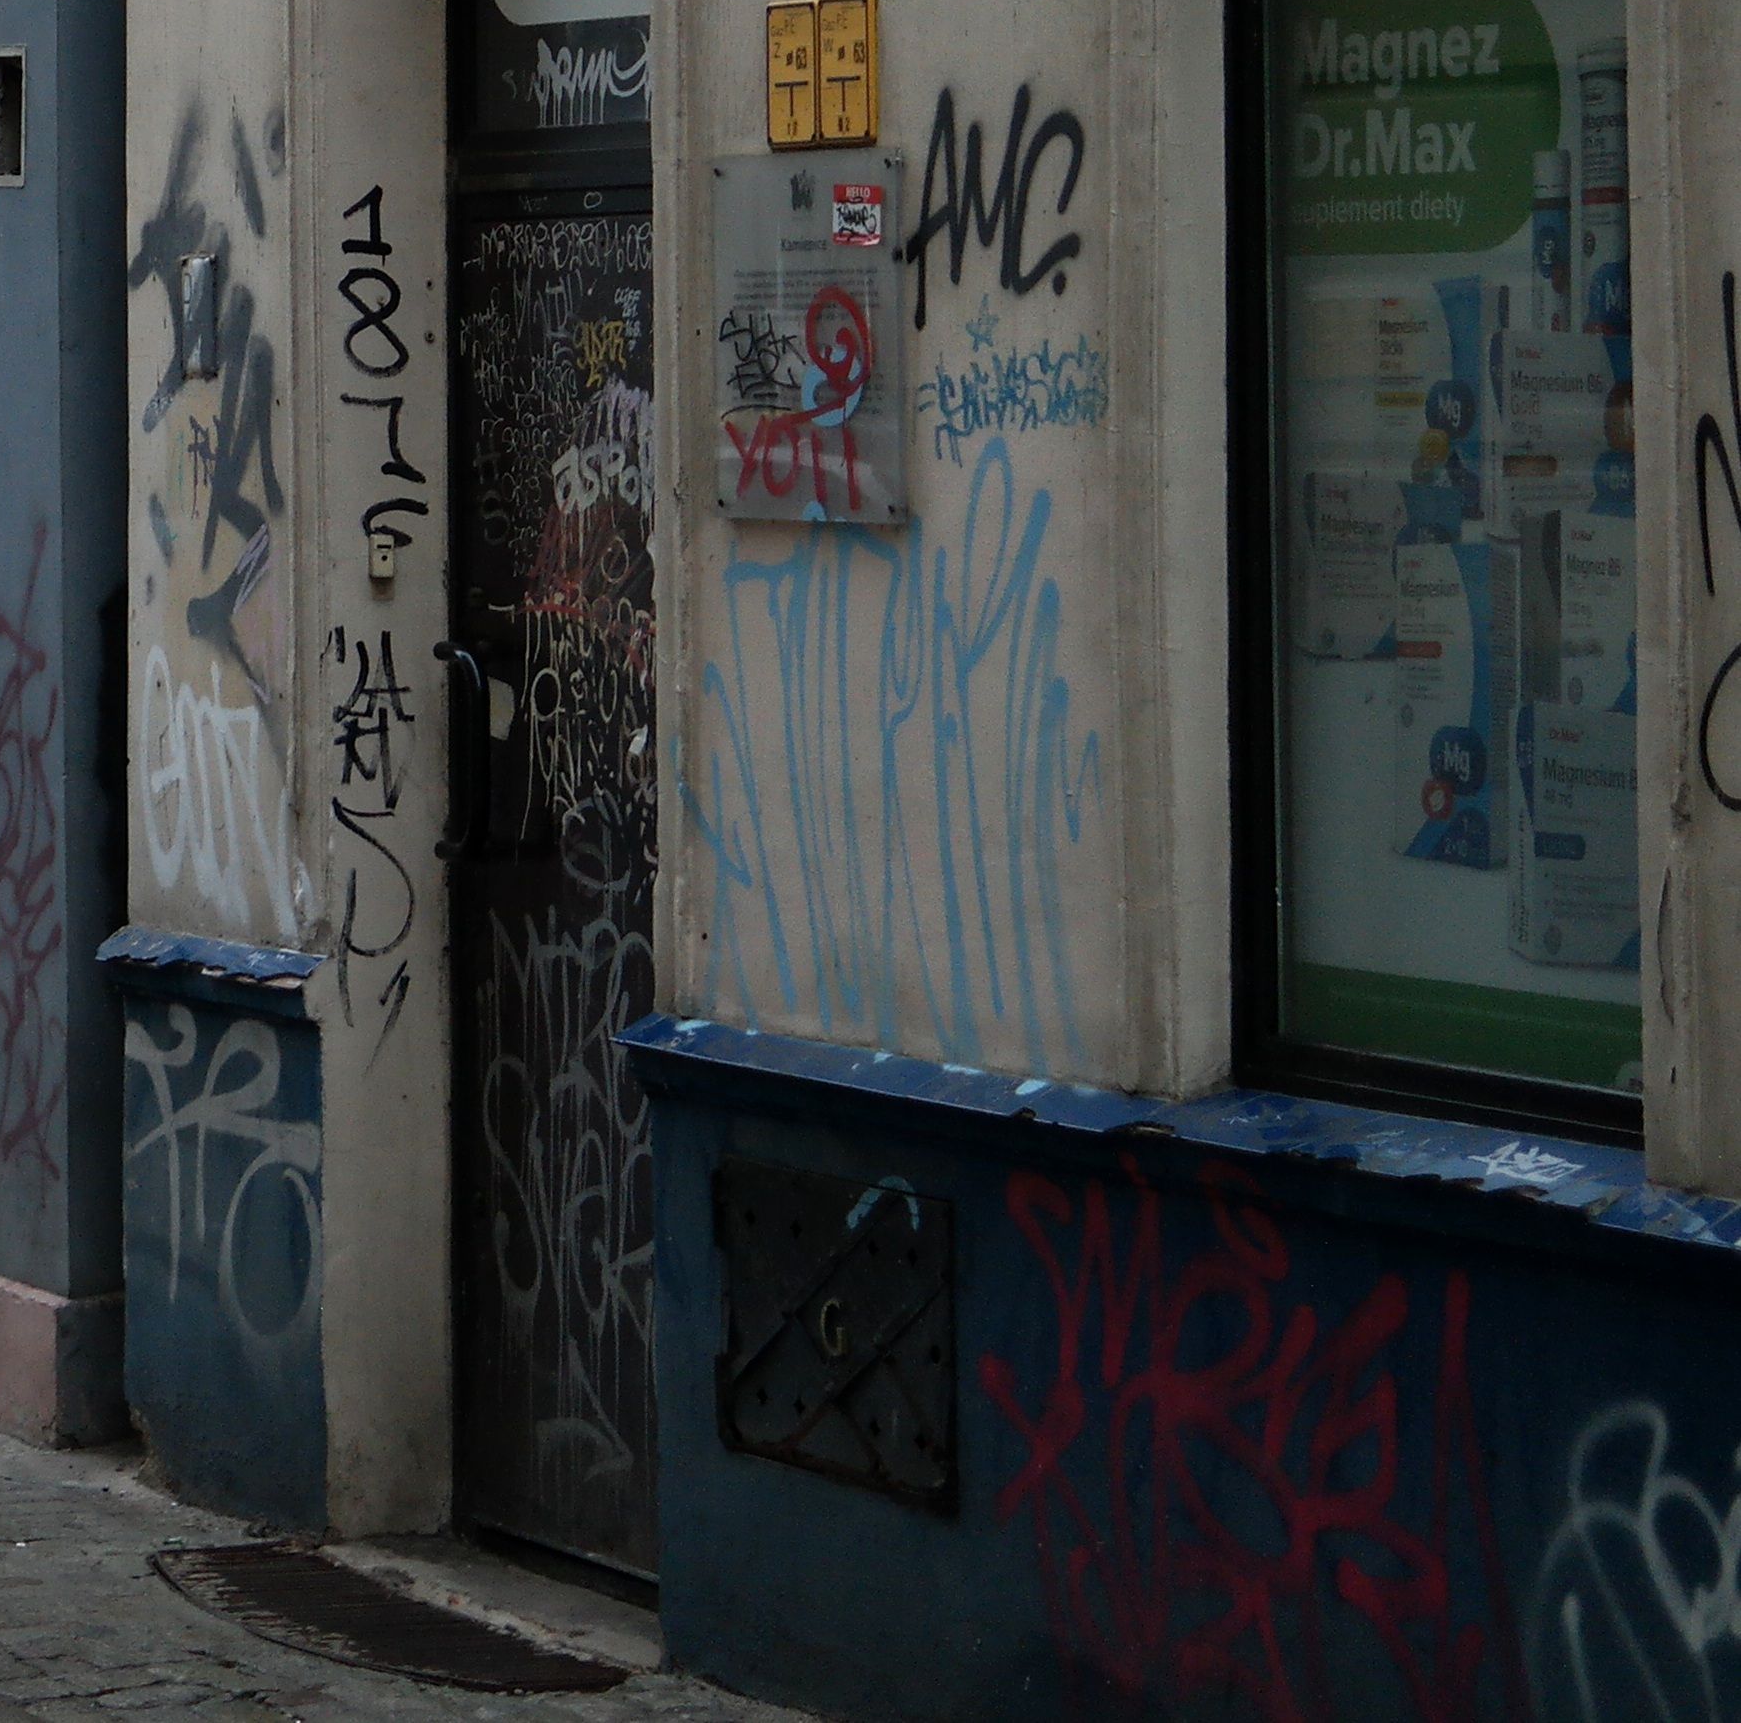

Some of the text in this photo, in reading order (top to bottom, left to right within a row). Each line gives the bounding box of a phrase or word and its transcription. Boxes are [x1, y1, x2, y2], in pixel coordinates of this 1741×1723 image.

[1294, 17, 1501, 99] Magnez
[1291, 107, 1478, 178] Dr.Max
[845, 186, 871, 198] HELLO
[1290, 190, 1466, 234] suplement diety
[1510, 371, 1585, 394] Magnesium
[1436, 391, 1463, 428] Mg
[1443, 742, 1471, 782] Mg
[1542, 757, 1626, 791] Magnesium
[821, 1298, 844, 1357] G
